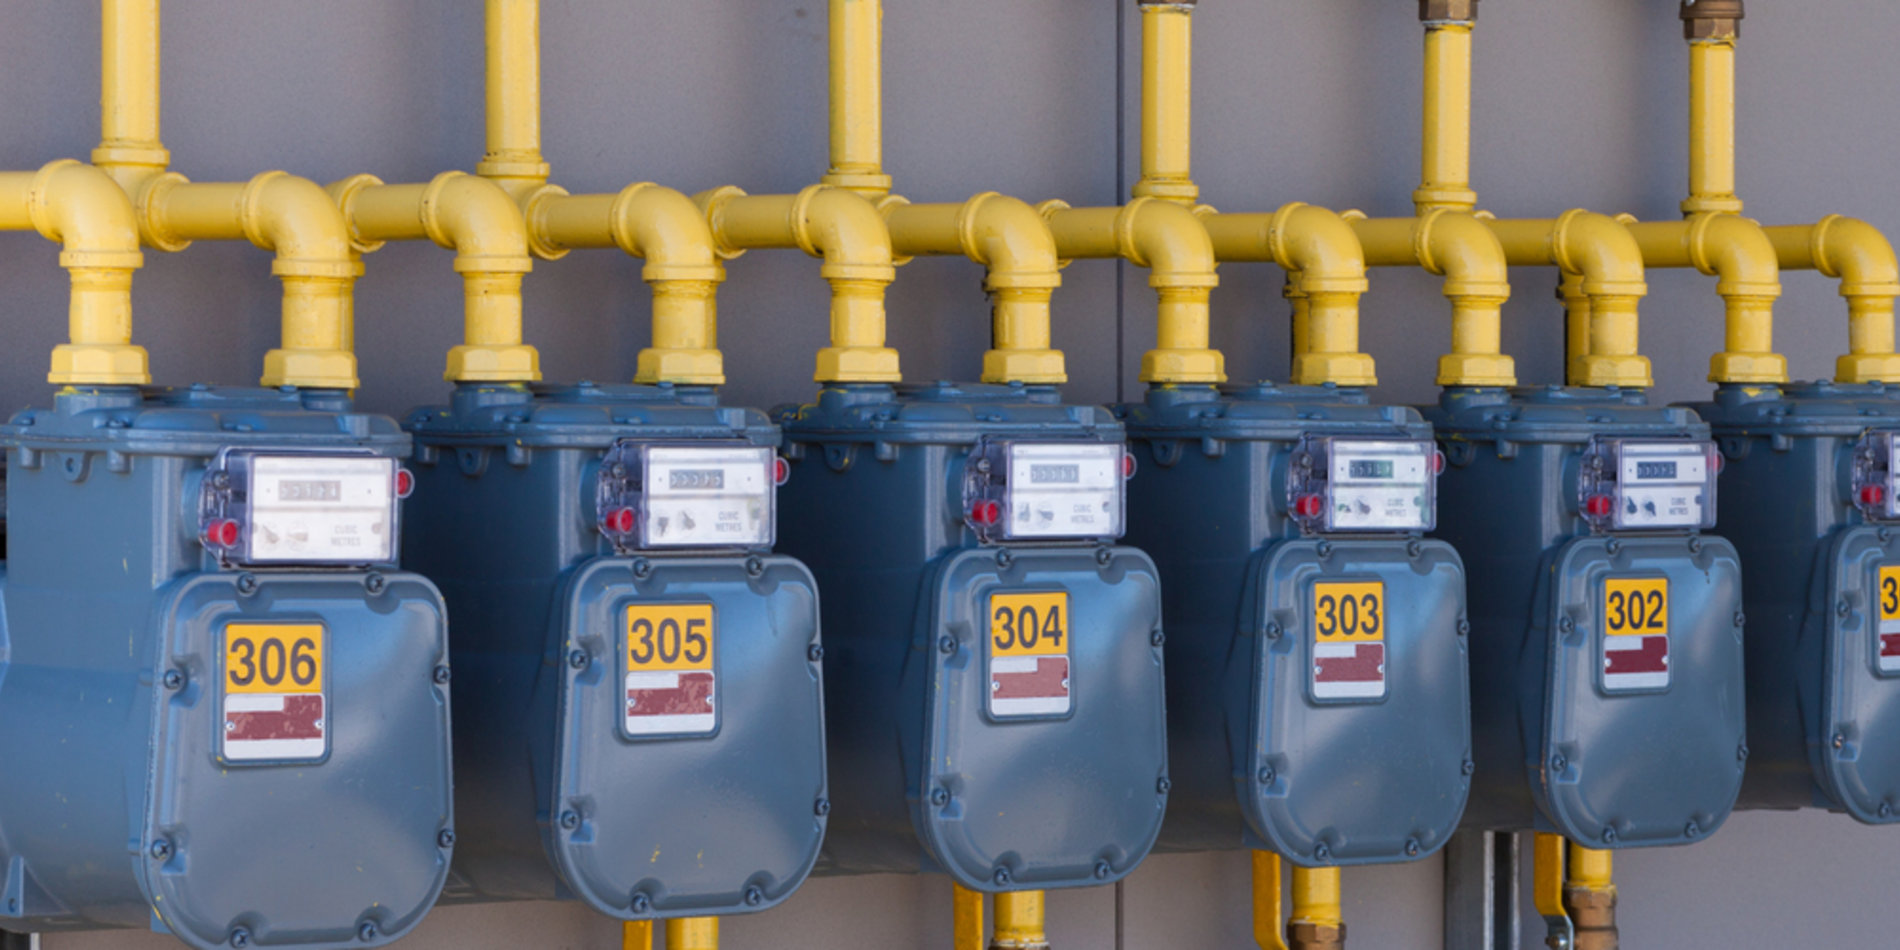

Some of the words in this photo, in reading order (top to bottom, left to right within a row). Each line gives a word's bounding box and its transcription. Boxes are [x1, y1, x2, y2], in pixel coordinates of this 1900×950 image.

[1317, 592, 1381, 638] 303
[1607, 589, 1665, 632] 302
[1882, 575, 1900, 616] 3
[631, 617, 708, 665] 305
[993, 605, 1064, 651] 304
[229, 637, 317, 687] 306
